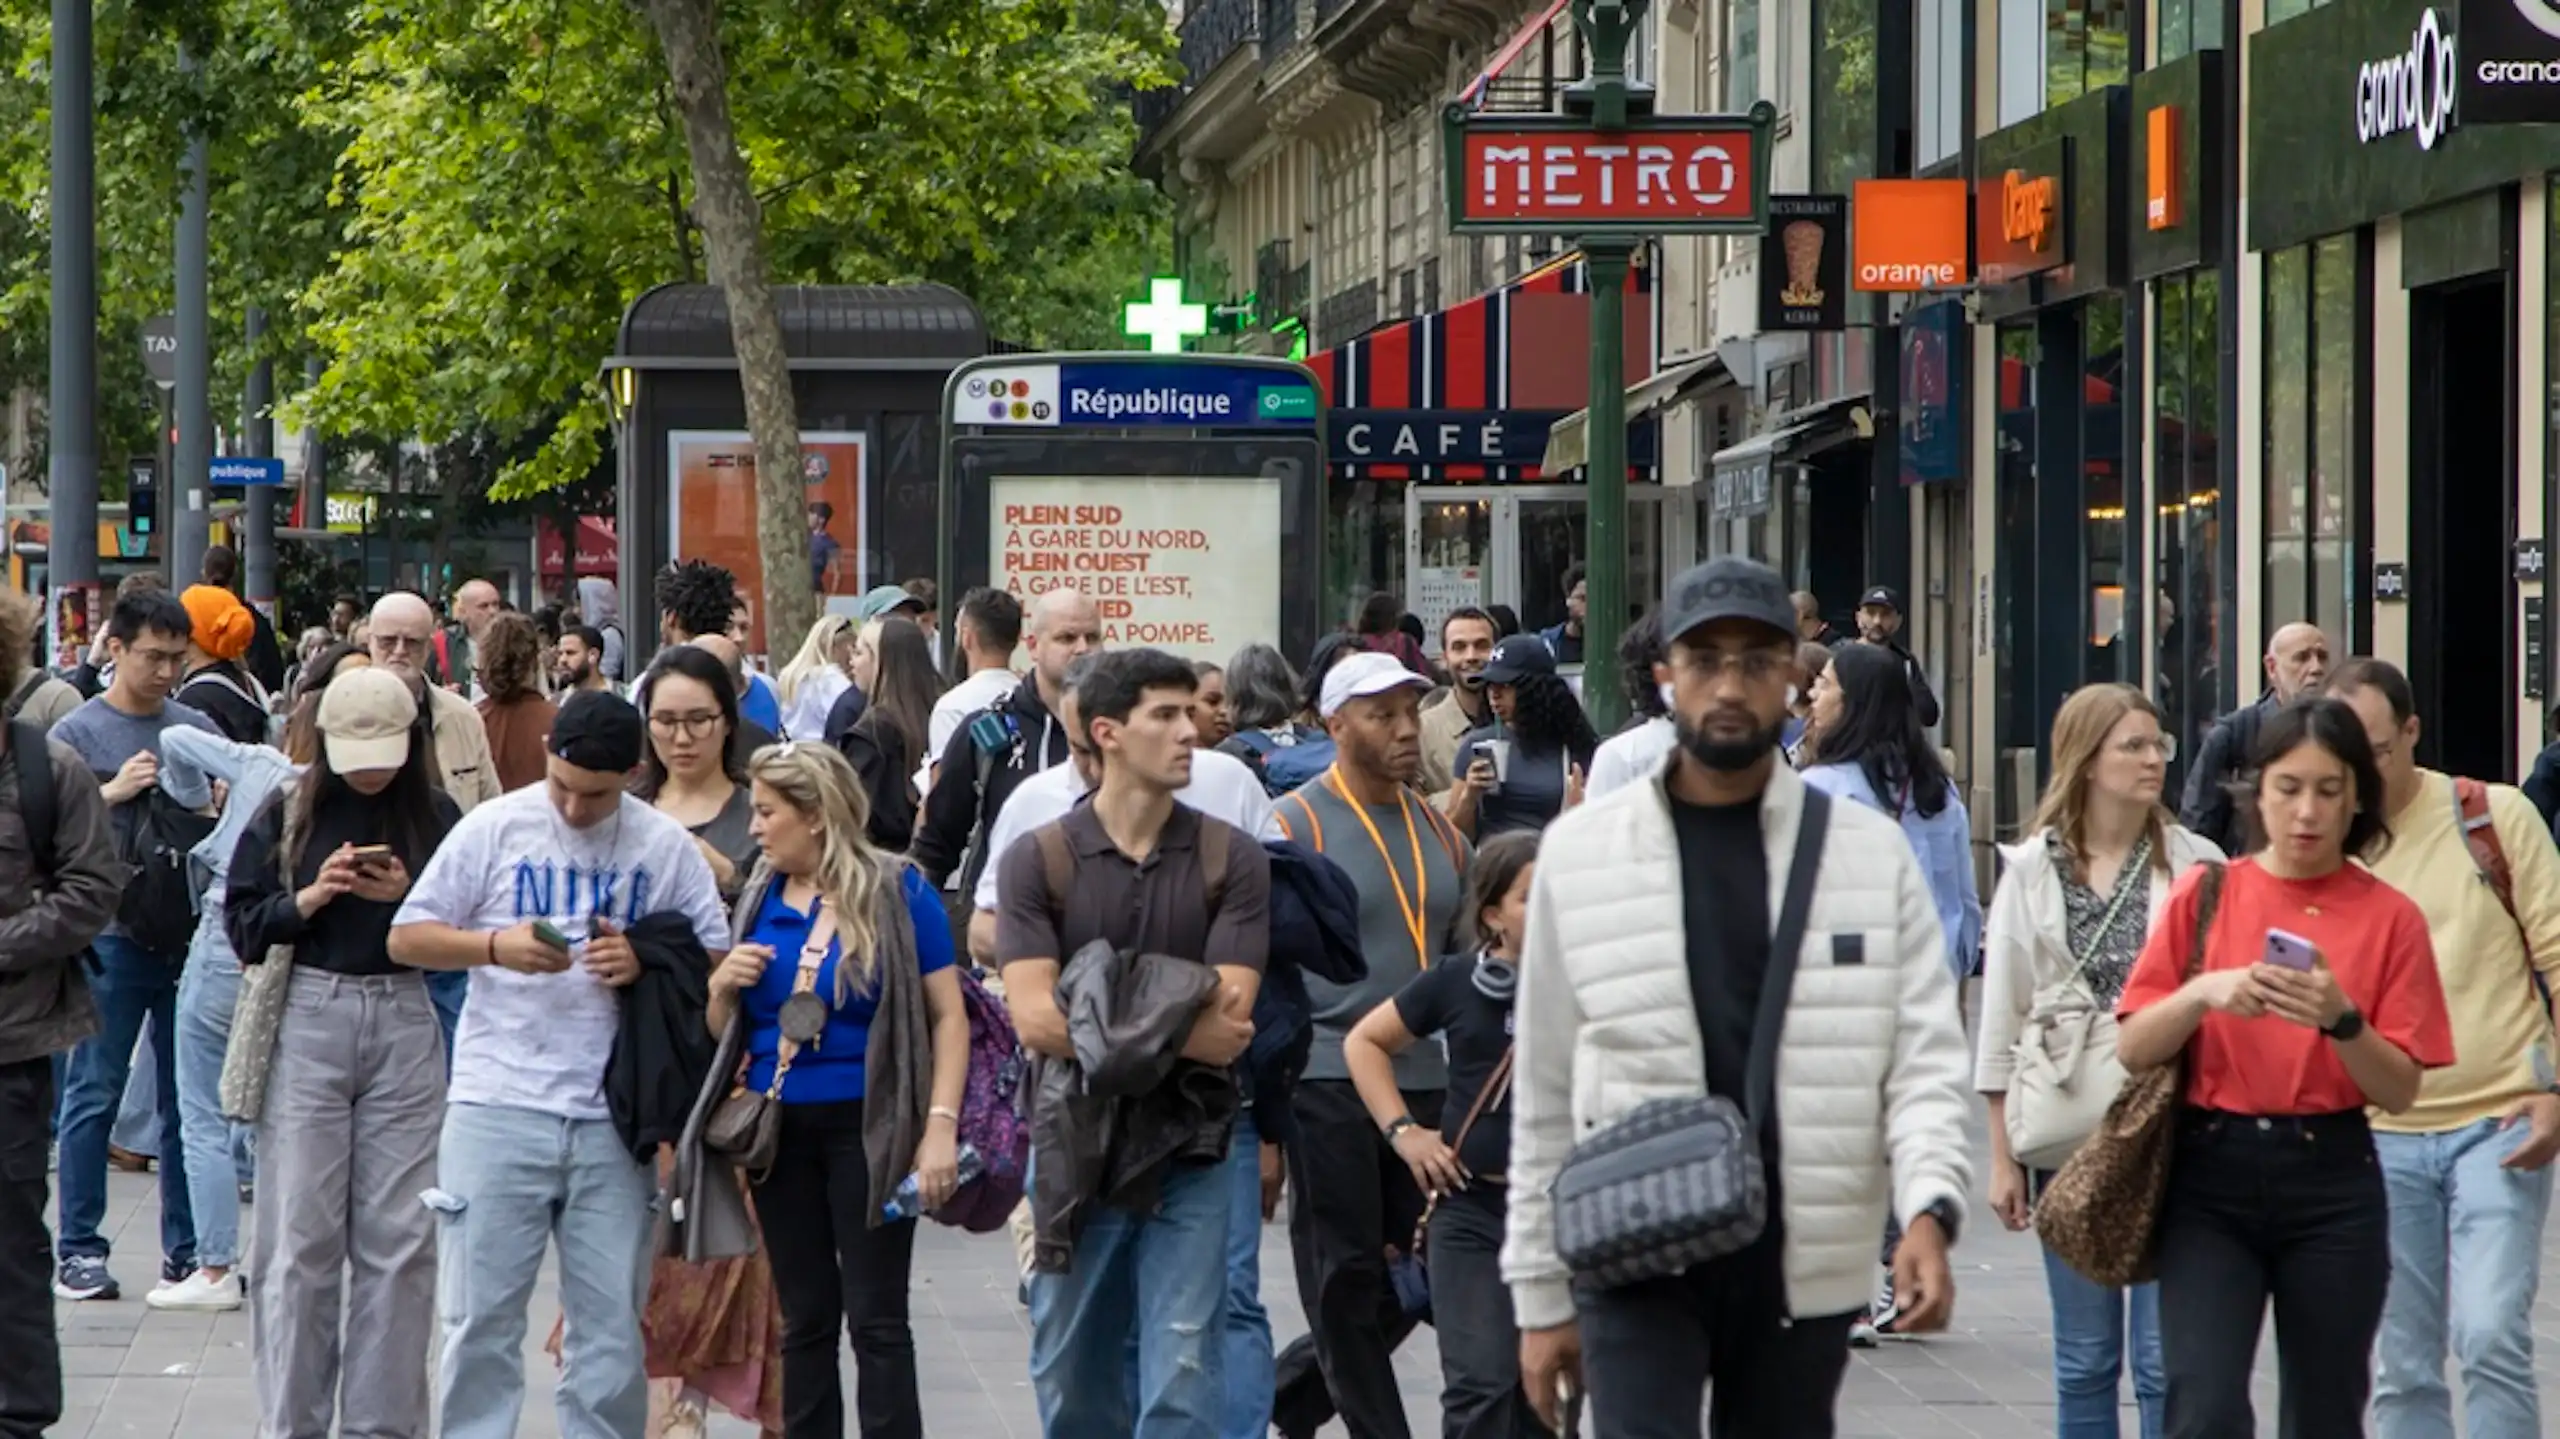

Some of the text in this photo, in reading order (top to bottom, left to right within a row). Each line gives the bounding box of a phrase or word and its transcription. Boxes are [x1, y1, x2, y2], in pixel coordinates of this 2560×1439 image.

[1484, 145, 1734, 206] METRO
[1861, 262, 1954, 284] orange
[1071, 387, 1231, 419] République
[1345, 418, 1503, 455] CAFÉ
[1005, 505, 1122, 525] PLEIN SUD
[1006, 522, 1210, 552] À GARE DU NORD,
[1005, 553, 1151, 572] PLEIN OUEST
[1098, 576, 1127, 595] DE
[1126, 623, 1215, 643] POMPE.
